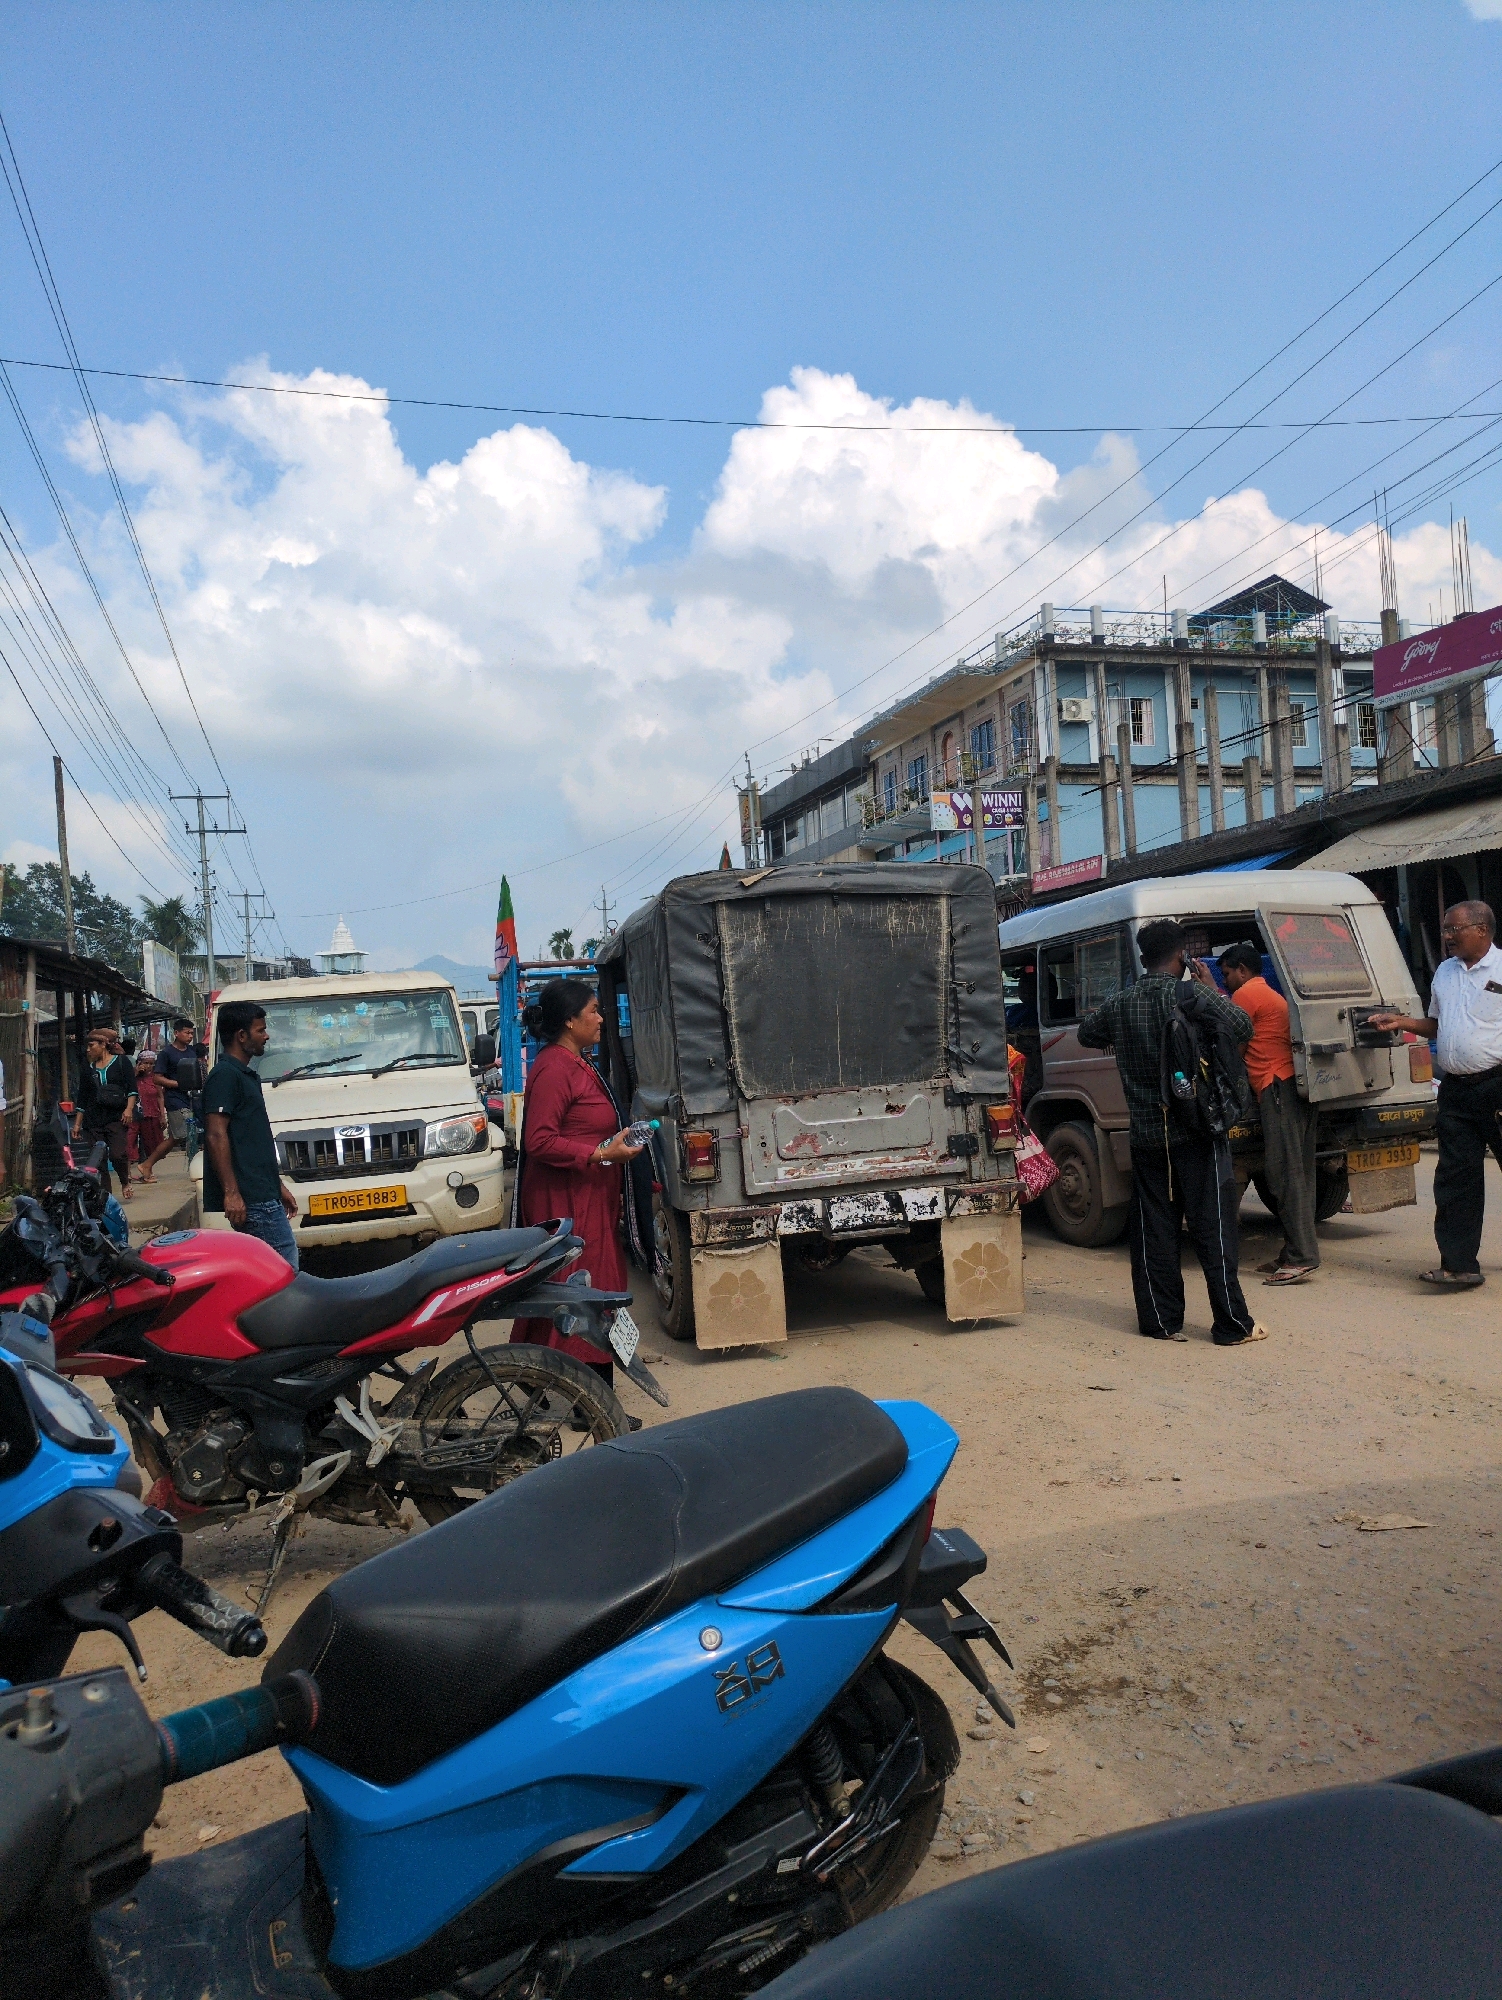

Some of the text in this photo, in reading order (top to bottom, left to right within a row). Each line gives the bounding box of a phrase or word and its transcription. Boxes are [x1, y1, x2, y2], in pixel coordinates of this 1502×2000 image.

[1400, 637, 1442, 672] Godrej
[981, 793, 1022, 808] WINNI
[1323, 1190, 1397, 1210] TR05E1883
